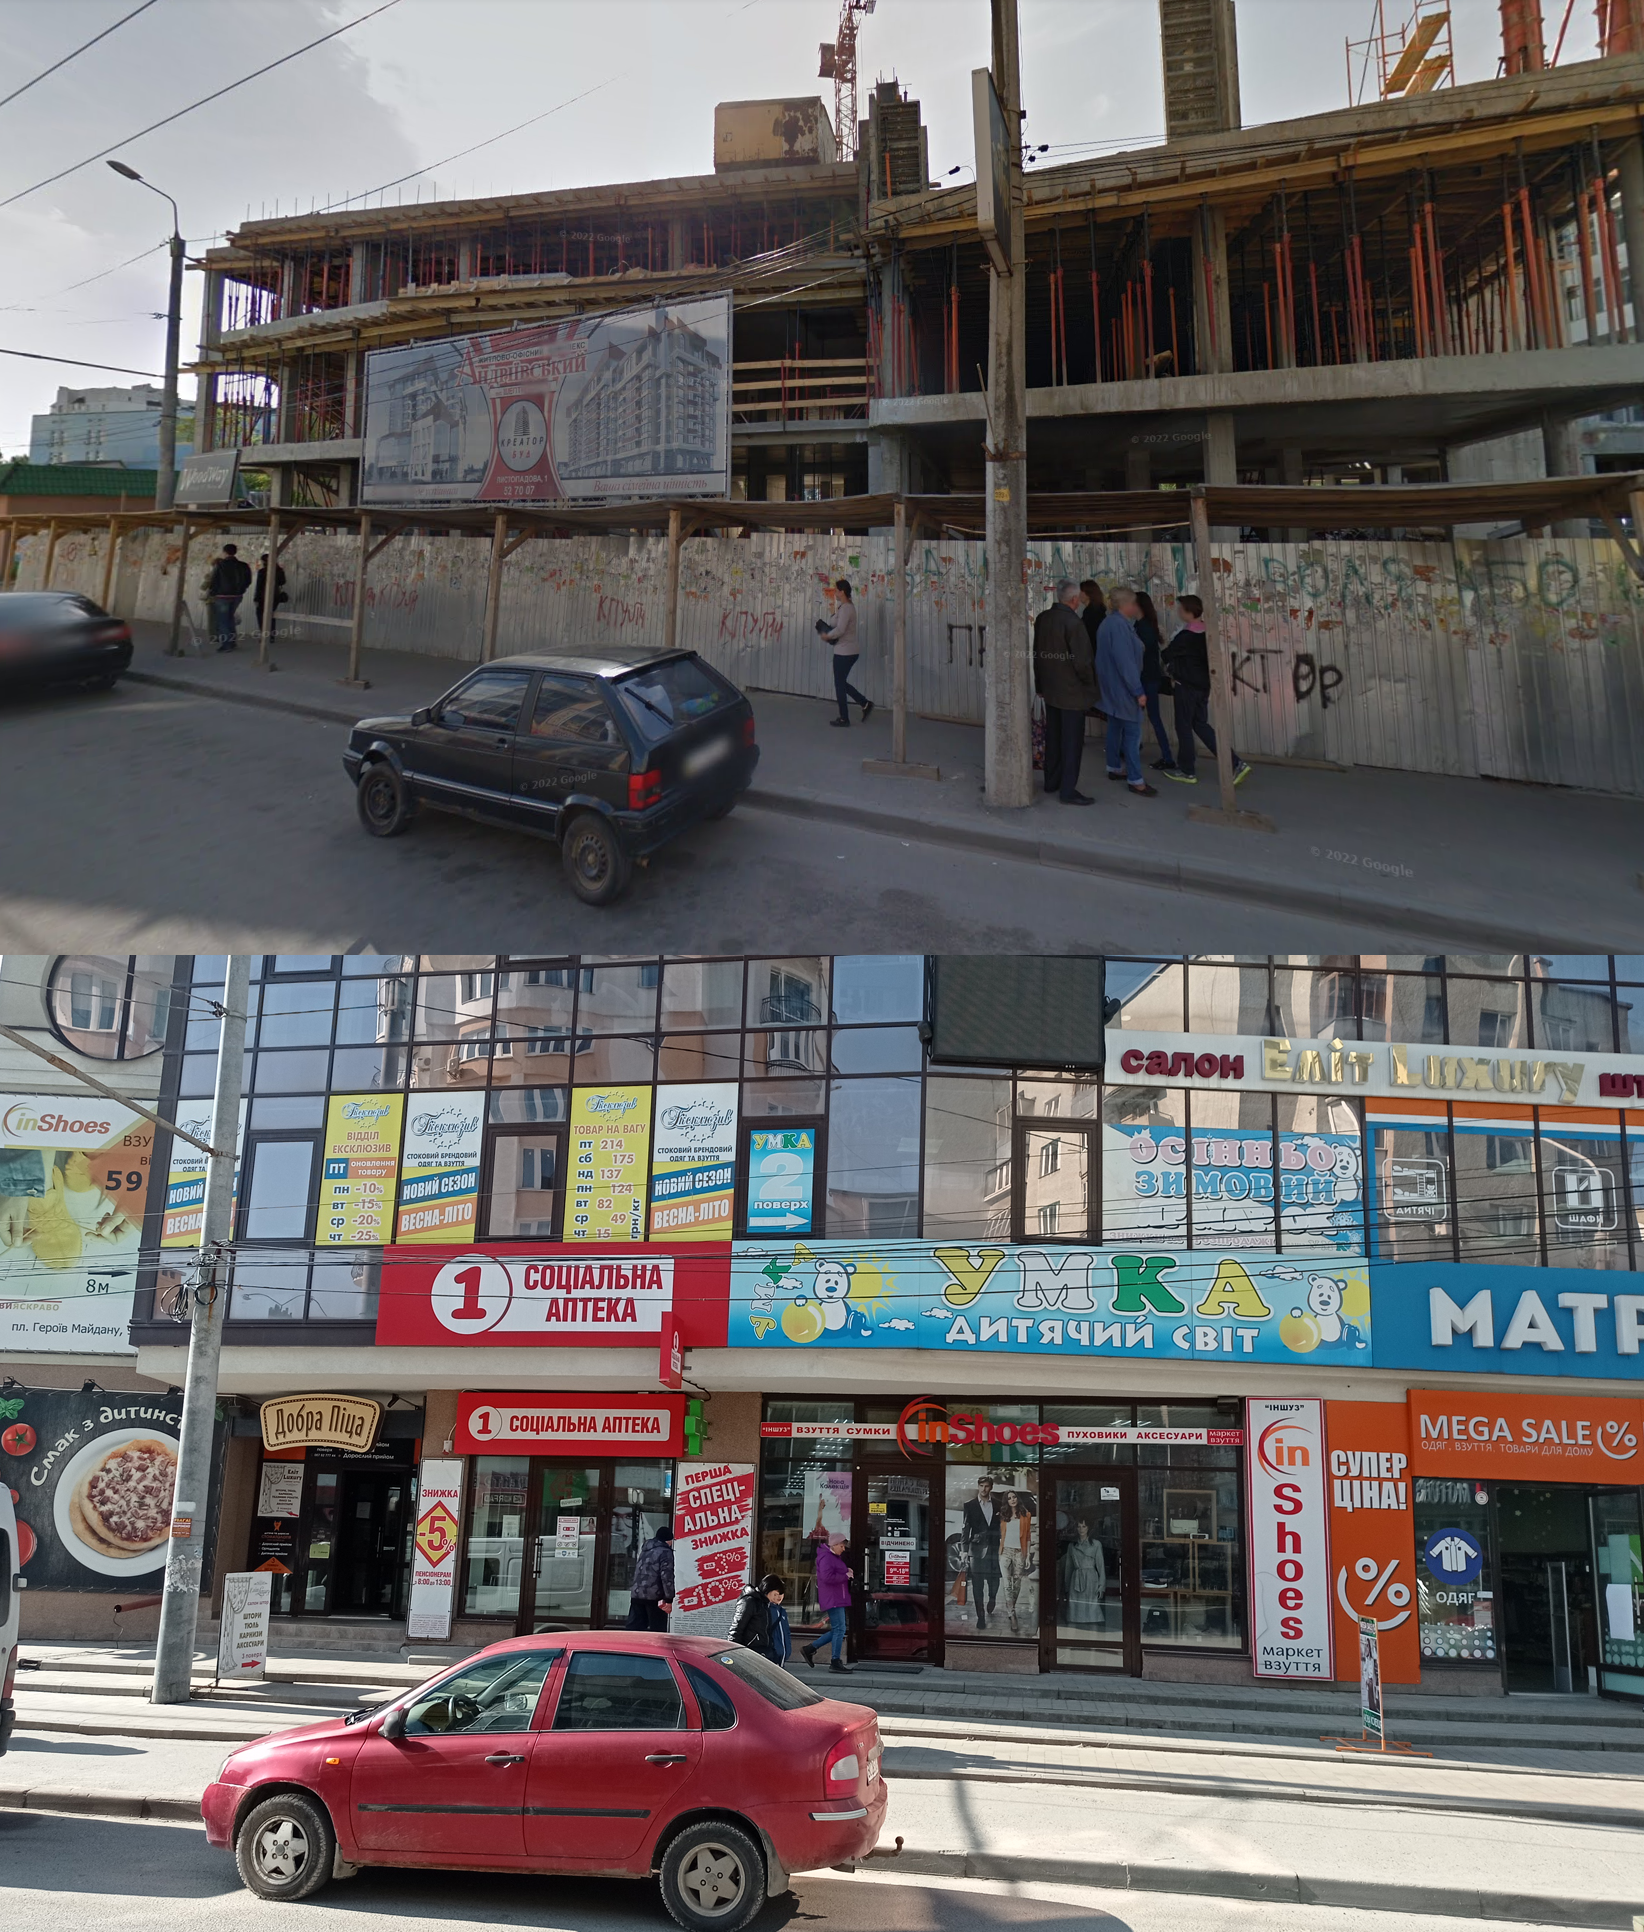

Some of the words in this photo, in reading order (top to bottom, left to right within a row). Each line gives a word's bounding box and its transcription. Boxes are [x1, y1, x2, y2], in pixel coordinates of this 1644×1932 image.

[500, 437, 545, 448] КРЕАТОР
[511, 450, 532, 459] БУД
[514, 486, 524, 496] 70
[525, 485, 536, 495] 07
[593, 480, 621, 492] Ваша
[1120, 1048, 1245, 1080] салон
[15, 1111, 112, 1137] inShoes
[573, 1125, 604, 1135] ТОВАР
[606, 1125, 620, 1134] НА
[622, 1124, 646, 1134] ВАГУ
[346, 1131, 380, 1142] ВІДДІЛ
[752, 1133, 811, 1150] УМКА
[332, 1143, 392, 1155] ЕКСКЛЮЗИВ
[599, 1138, 624, 1150] 214
[657, 1146, 692, 1155] СТОКОВИЙ
[693, 1144, 733, 1154] БРЕНДОВИЙ
[407, 1151, 440, 1161] СТОКОВИЙ
[441, 1150, 478, 1159] БРЕНДОВИЙ
[579, 1154, 593, 1164] сб
[612, 1153, 634, 1165] 175
[669, 1155, 686, 1163] ОДЯГ
[1129, 1136, 1338, 1172] ОСІННЬО
[329, 1162, 347, 1175] ПТ
[350, 1160, 396, 1169] оновлення
[417, 1160, 433, 1168] ОДЯГ
[358, 1167, 387, 1178] товару
[577, 1170, 594, 1180] нд
[599, 1169, 622, 1180] 137
[759, 1152, 804, 1199] 2
[403, 1179, 440, 1200] НОВИЙ
[441, 1172, 476, 1193] СЕЗОН
[655, 1172, 694, 1196] НОВИЙ
[694, 1167, 732, 1190] СЕЗОН
[1134, 1170, 1338, 1205] ЗИМОВИЙ
[167, 1181, 206, 1205] НОВИЙ
[333, 1186, 351, 1196] пн
[355, 1182, 384, 1196] -10%
[576, 1184, 592, 1193] пн
[610, 1183, 634, 1195] 124
[332, 1201, 347, 1211] вт
[354, 1197, 382, 1210] -15%
[575, 1199, 589, 1208] вт
[595, 1198, 613, 1210] 82
[753, 1199, 810, 1213] поверх
[402, 1202, 473, 1232] ВЕСНА-ЛІТО
[574, 1214, 589, 1225] ср
[610, 1213, 627, 1224] 49
[630, 1198, 642, 1239] грн/кг
[653, 1198, 730, 1229] ВЕСНА-ЛІТО
[331, 1216, 346, 1228] ср
[352, 1214, 381, 1227] -20%
[329, 1231, 343, 1242] чт
[350, 1229, 380, 1243] -25%
[573, 1228, 587, 1238] чт
[595, 1228, 611, 1239] 15
[523, 1264, 663, 1294] СОЦІАЛЬНА
[932, 1246, 1272, 1318] УМКА
[451, 1265, 487, 1320] 1
[544, 1296, 639, 1323] АПТЕКА
[11, 1322, 29, 1333] пл.
[32, 1321, 68, 1335] Героїв
[71, 1323, 123, 1338] Майдану,
[944, 1313, 1154, 1349] ДИТЯЧИЙ
[1171, 1325, 1261, 1354] СВІТ
[274, 1404, 323, 1441] Добра
[328, 1404, 366, 1440] Піца
[476, 1411, 494, 1434] 1
[509, 1414, 598, 1436] СОЦІАЛЬНА
[601, 1415, 661, 1434] АПТЕКА
[917, 1411, 1061, 1446] inShoes
[1419, 1413, 1514, 1443] MEGA
[1521, 1417, 1593, 1446] SALE
[796, 1426, 840, 1434] ВЗУТТЯ
[846, 1427, 891, 1436] СУМКИ
[1067, 1430, 1127, 1440] ПУХОВИКИ
[1136, 1431, 1203, 1441] АКСЕСУАРИ
[1209, 1430, 1241, 1438] маркет
[1209, 1437, 1240, 1445] взуття
[31, 1428, 81, 1487] Смак
[82, 1418, 96, 1432] з
[1274, 1437, 1310, 1467] in
[1499, 1443, 1539, 1454] ТОВАРИ
[1541, 1446, 1564, 1456] ДЛЯ
[1565, 1447, 1595, 1458] ДОМУ
[1330, 1449, 1408, 1480] СУПЕР
[684, 1465, 733, 1486] ПЕРША
[422, 1488, 459, 1499] ЗНИЖКА
[688, 1482, 746, 1509] СПЕЦІ-
[1333, 1478, 1408, 1513] ЦІНА!
[683, 1504, 743, 1533] АЛЬНА
[690, 1527, 750, 1551] ЗНИЖКА
[1272, 1482, 1304, 1641] Shoes
[1435, 1591, 1476, 1607] ОДЯГ
[243, 1612, 262, 1620] ШТОРИ
[244, 1622, 259, 1630] ТЮЛЬ
[1262, 1645, 1325, 1661] маркет
[1263, 1660, 1323, 1674] взуття
